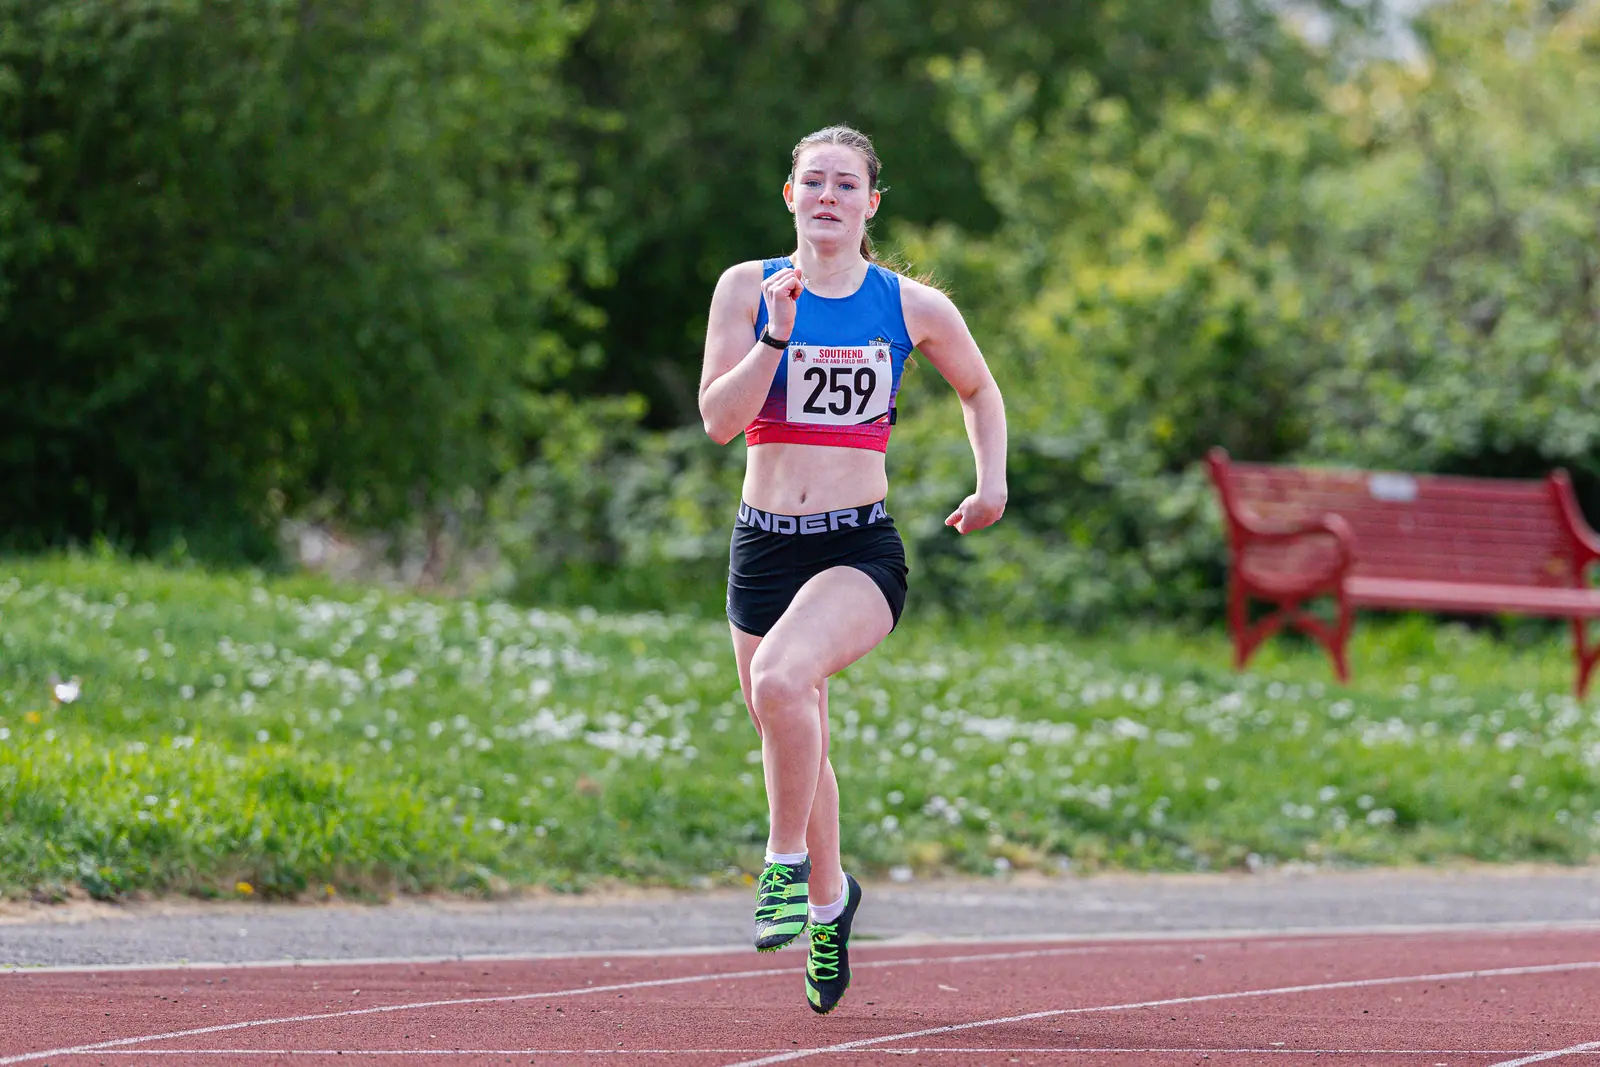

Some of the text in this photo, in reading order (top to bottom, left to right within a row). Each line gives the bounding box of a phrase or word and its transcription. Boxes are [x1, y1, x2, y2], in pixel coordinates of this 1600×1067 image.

[819, 349, 863, 359] SOUTHEND
[803, 367, 876, 416] 259
[738, 501, 860, 535] UNDER
